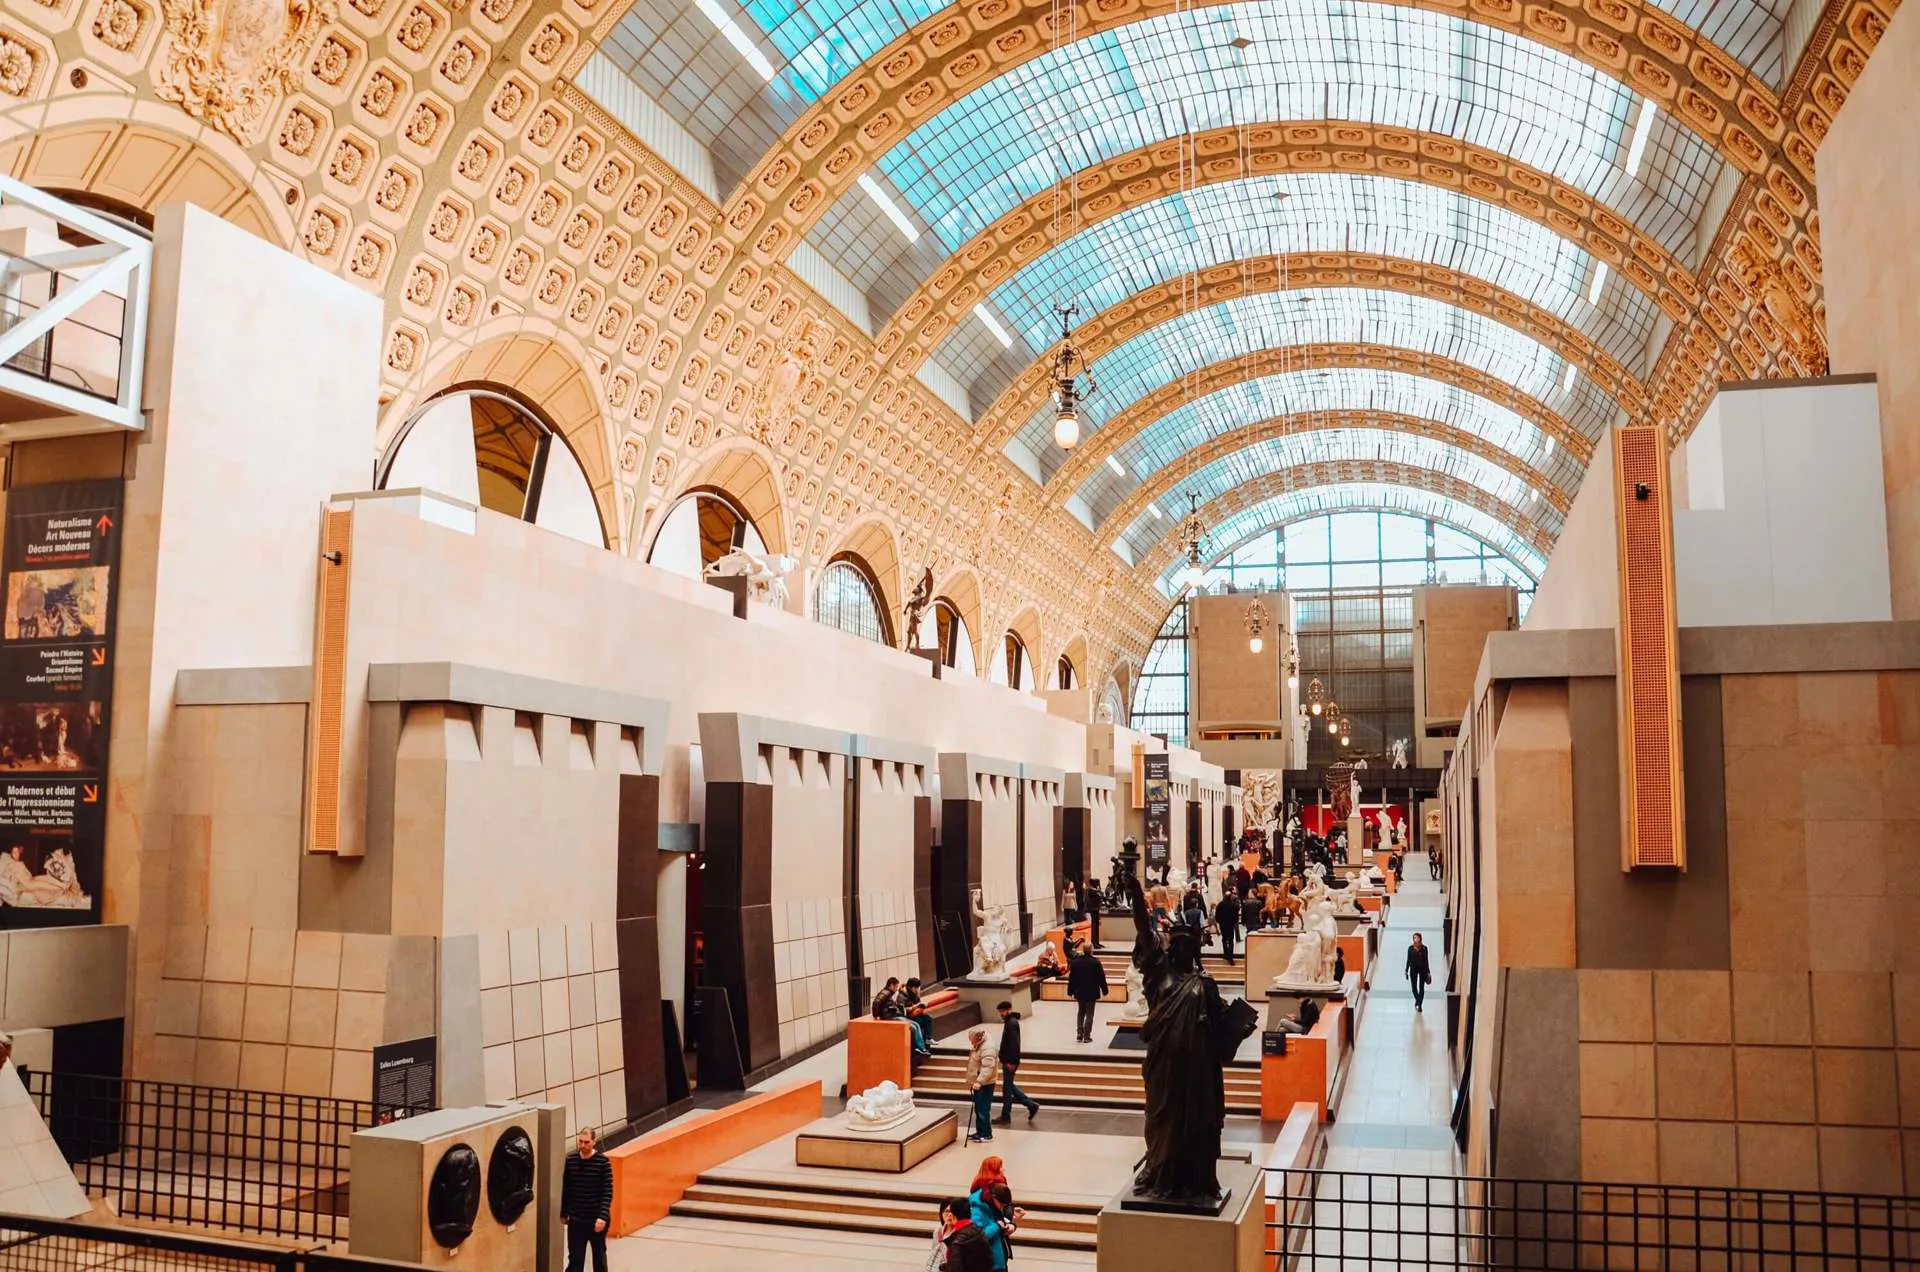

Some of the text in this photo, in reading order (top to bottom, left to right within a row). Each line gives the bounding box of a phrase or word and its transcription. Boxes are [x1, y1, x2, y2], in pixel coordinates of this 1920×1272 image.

[48, 518, 92, 529] Naturalisme
[46, 530, 91, 540] Art Nouveau
[28, 540, 91, 554] Décors modernes
[7, 785, 76, 796] Modernes et début
